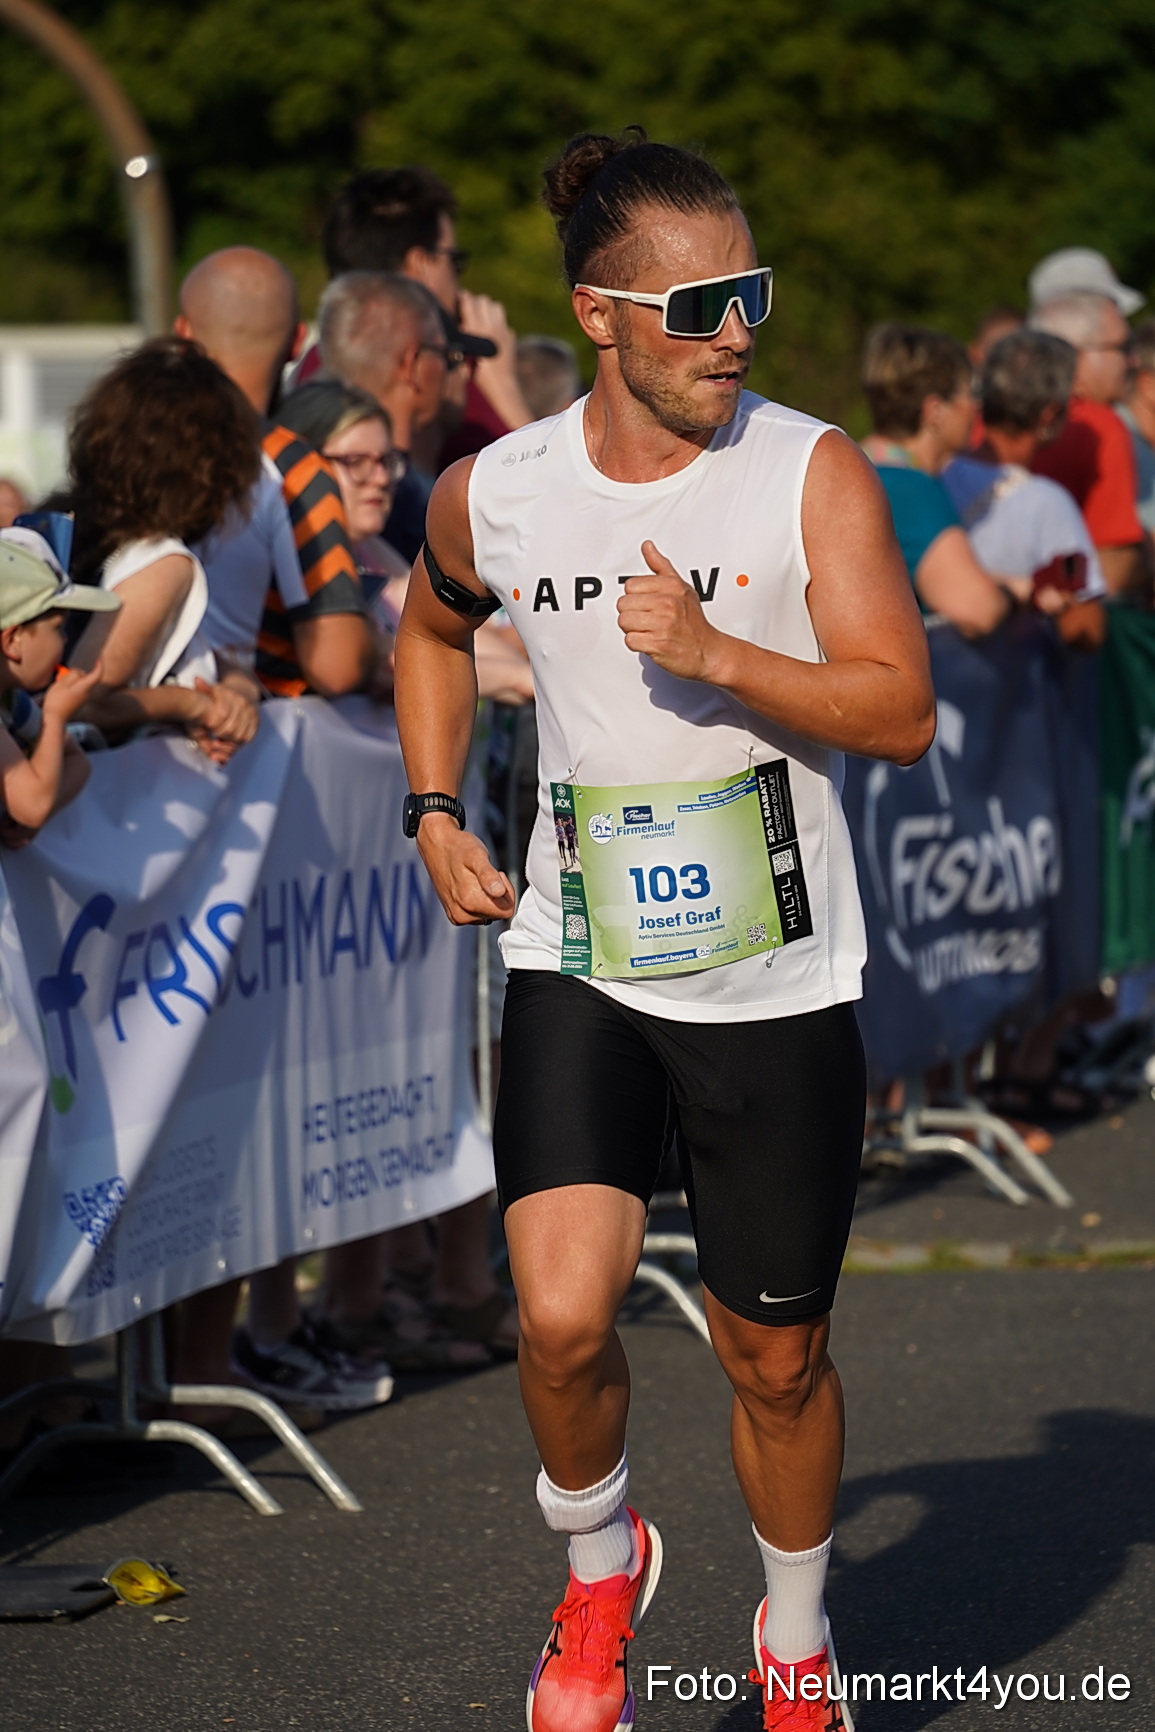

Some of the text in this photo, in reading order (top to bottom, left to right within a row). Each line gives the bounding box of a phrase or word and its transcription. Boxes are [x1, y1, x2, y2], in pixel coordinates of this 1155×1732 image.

[533, 567, 721, 613] APV
[758, 775, 772, 818] RABATT
[768, 773, 779, 804] OUTLET
[555, 798, 571, 809] AOK
[616, 819, 676, 837] Firmenlauf
[640, 830, 676, 840] neumarkt
[773, 805, 784, 840] FACTORY
[766, 828, 776, 844] 20
[628, 863, 711, 905] 103
[780, 876, 798, 930] HILTL
[638, 905, 722, 930] Josef Graf
[652, 931, 676, 940] Services
[675, 926, 709, 937] Deutschland
[633, 952, 695, 967] firmenlauf.bayern
